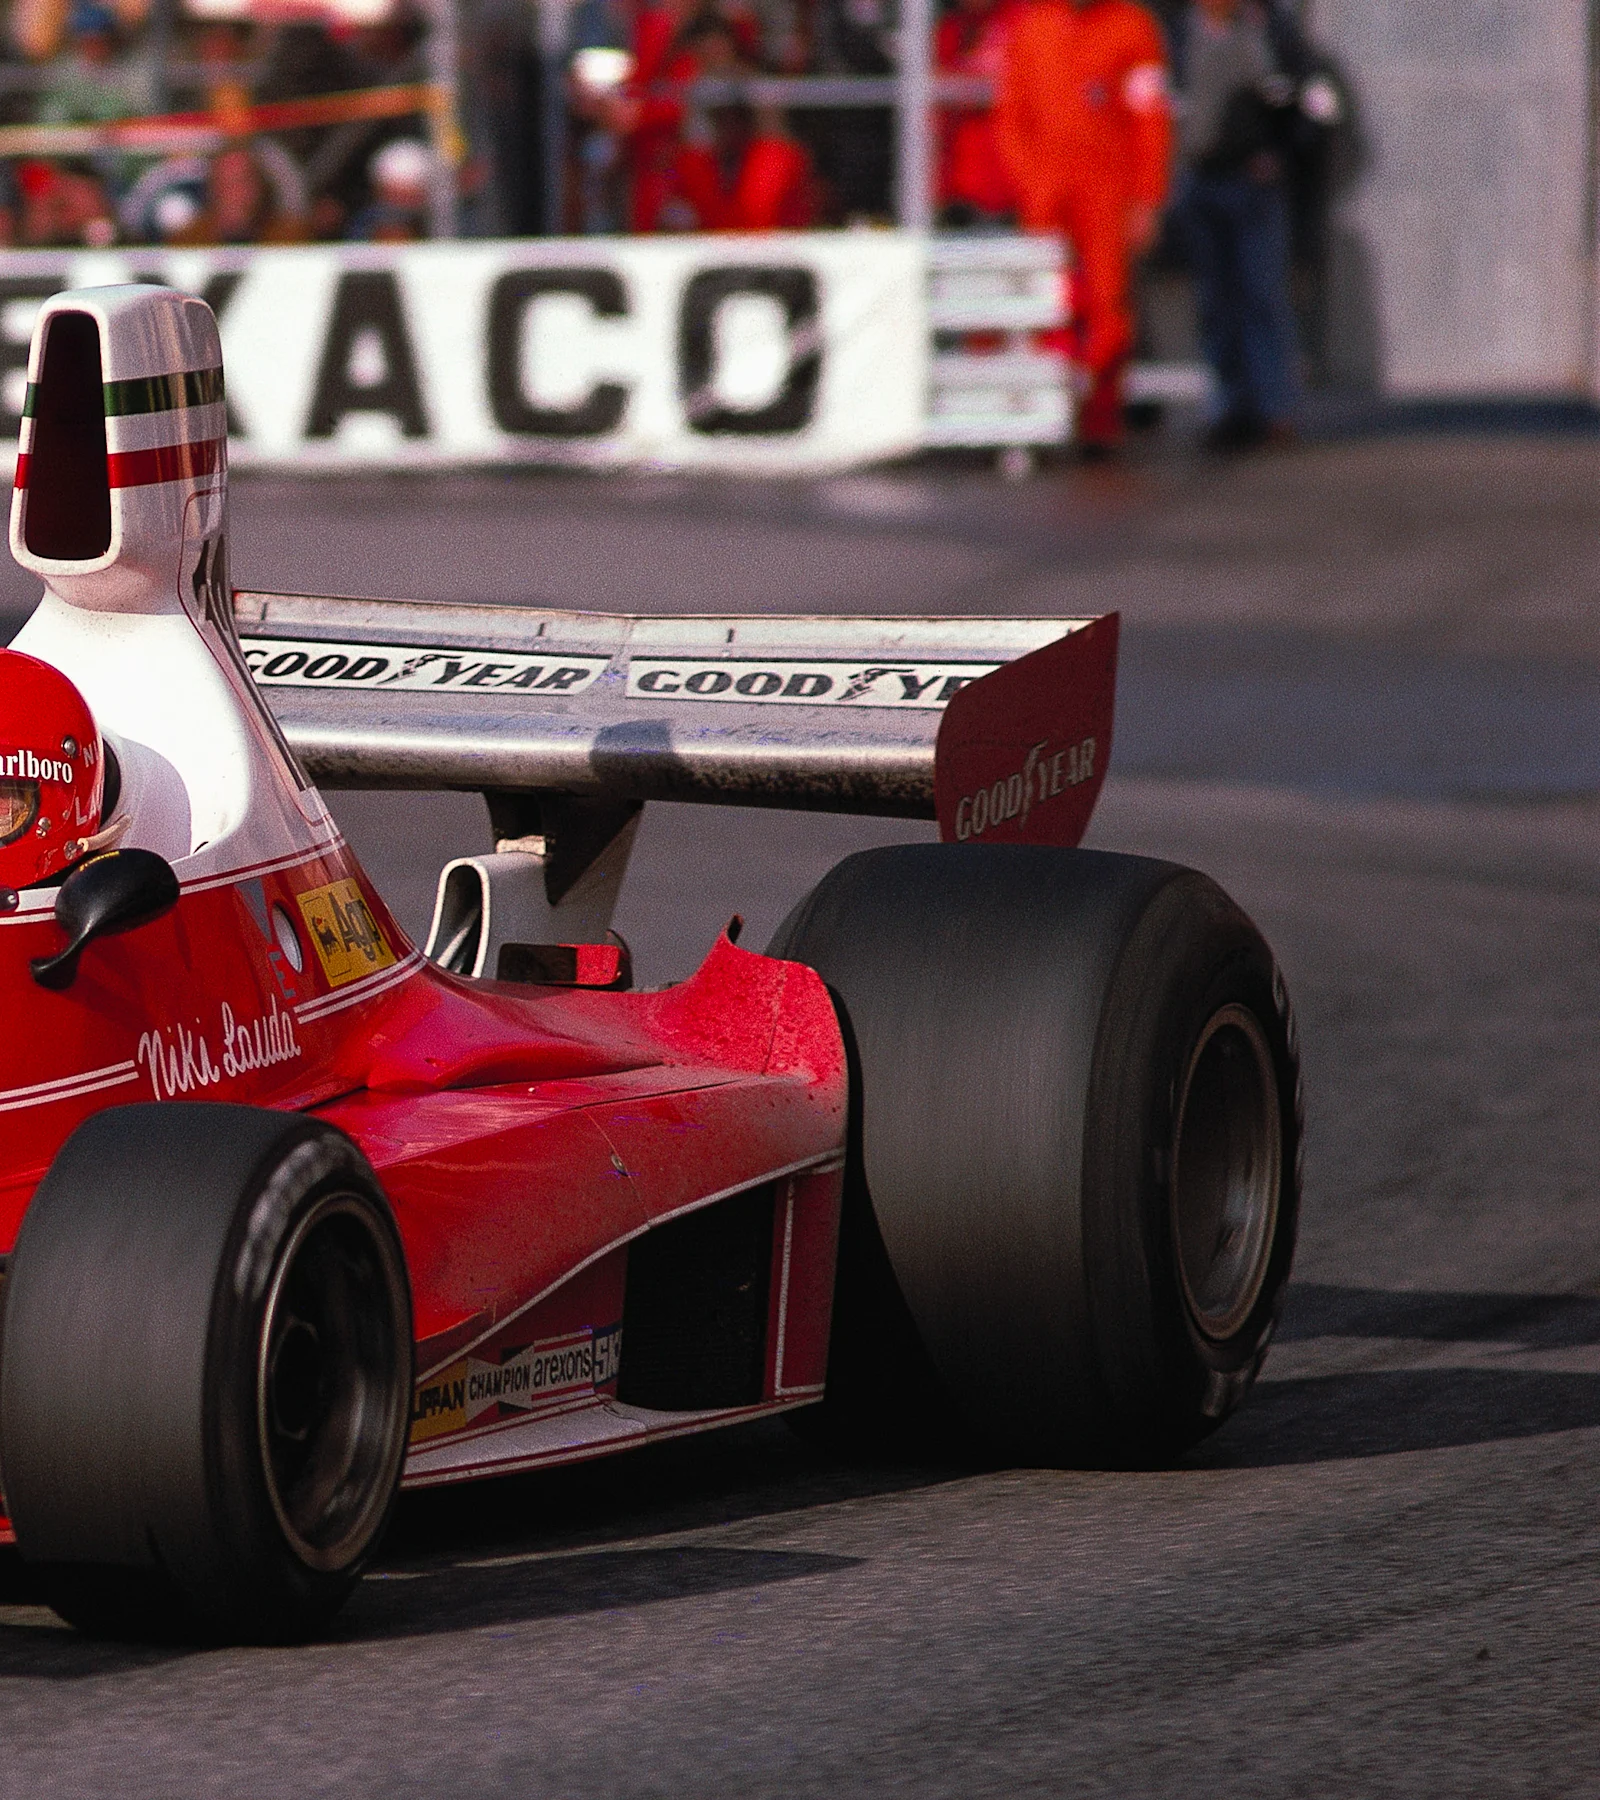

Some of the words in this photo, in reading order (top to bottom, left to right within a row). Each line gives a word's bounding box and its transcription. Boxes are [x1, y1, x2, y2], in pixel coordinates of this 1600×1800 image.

[432, 661, 590, 690] YEAR
[328, 887, 385, 962] Agip
[138, 1015, 220, 1101] Niki
[222, 994, 301, 1078] Lauda
[469, 1365, 532, 1400] CHAMPION
[533, 1347, 592, 1389] arexons
